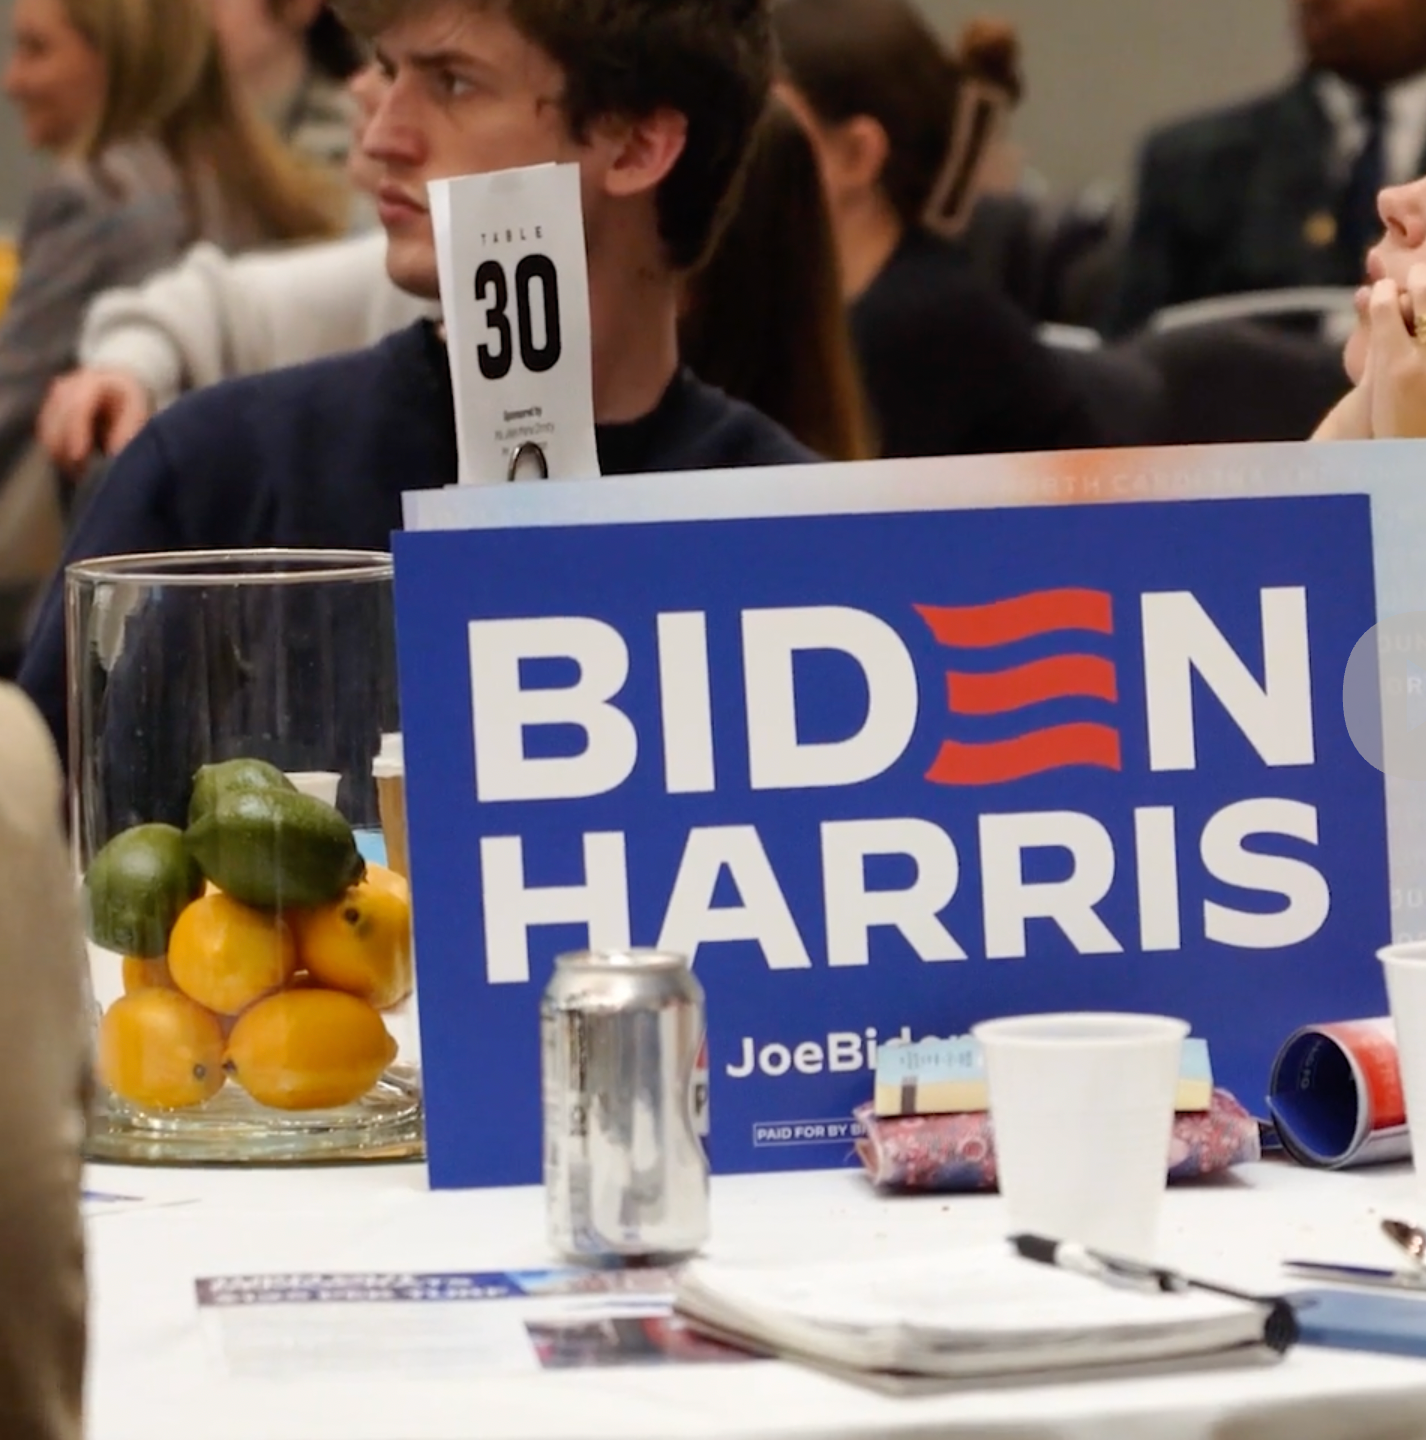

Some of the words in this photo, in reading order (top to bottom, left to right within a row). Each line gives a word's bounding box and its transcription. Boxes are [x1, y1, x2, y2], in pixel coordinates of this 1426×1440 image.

[480, 225, 543, 246] TABLE
[474, 253, 561, 380] 30
[468, 585, 1315, 802] BIDEN
[480, 797, 1330, 984] HARRIS
[757, 1126, 792, 1141] PAID
[794, 1124, 826, 1139] FOR
[827, 1123, 848, 1138] BY
